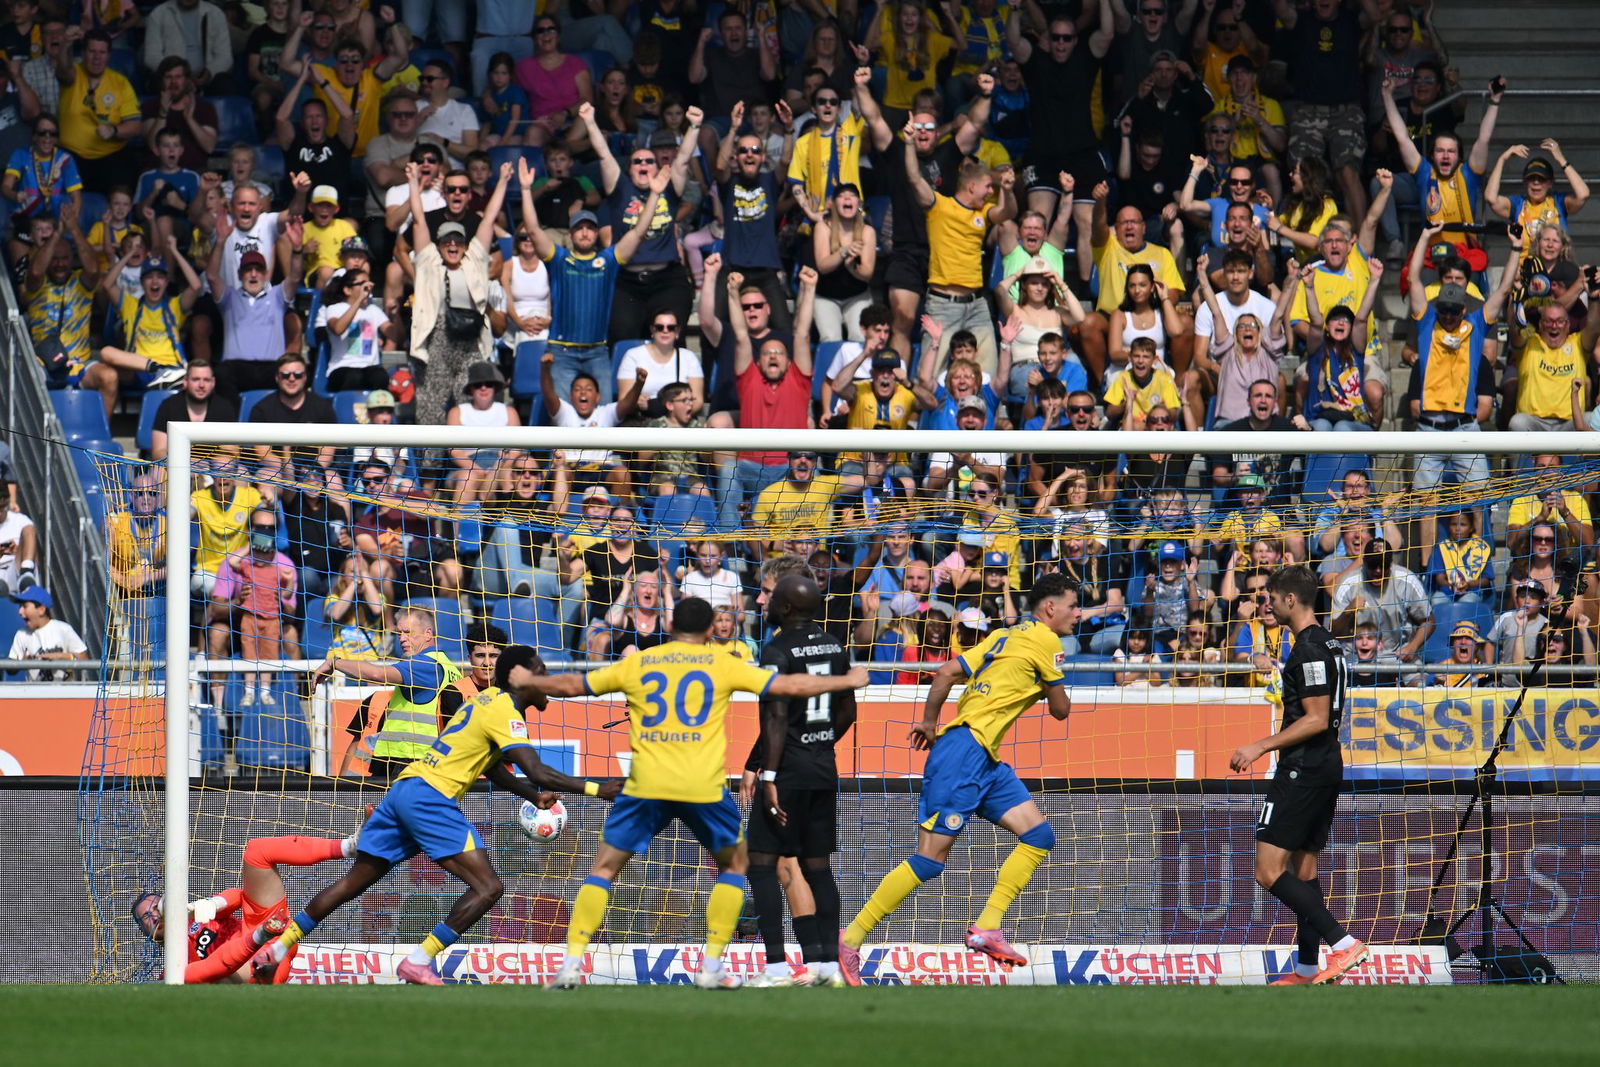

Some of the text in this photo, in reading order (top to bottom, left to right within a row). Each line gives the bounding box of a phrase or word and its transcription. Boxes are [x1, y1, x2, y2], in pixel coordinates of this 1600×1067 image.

[1539, 359, 1574, 376] heycar
[640, 670, 714, 728] 30
[1338, 698, 1600, 751] ESSING
[1052, 948, 1222, 985] KÜCHEN
